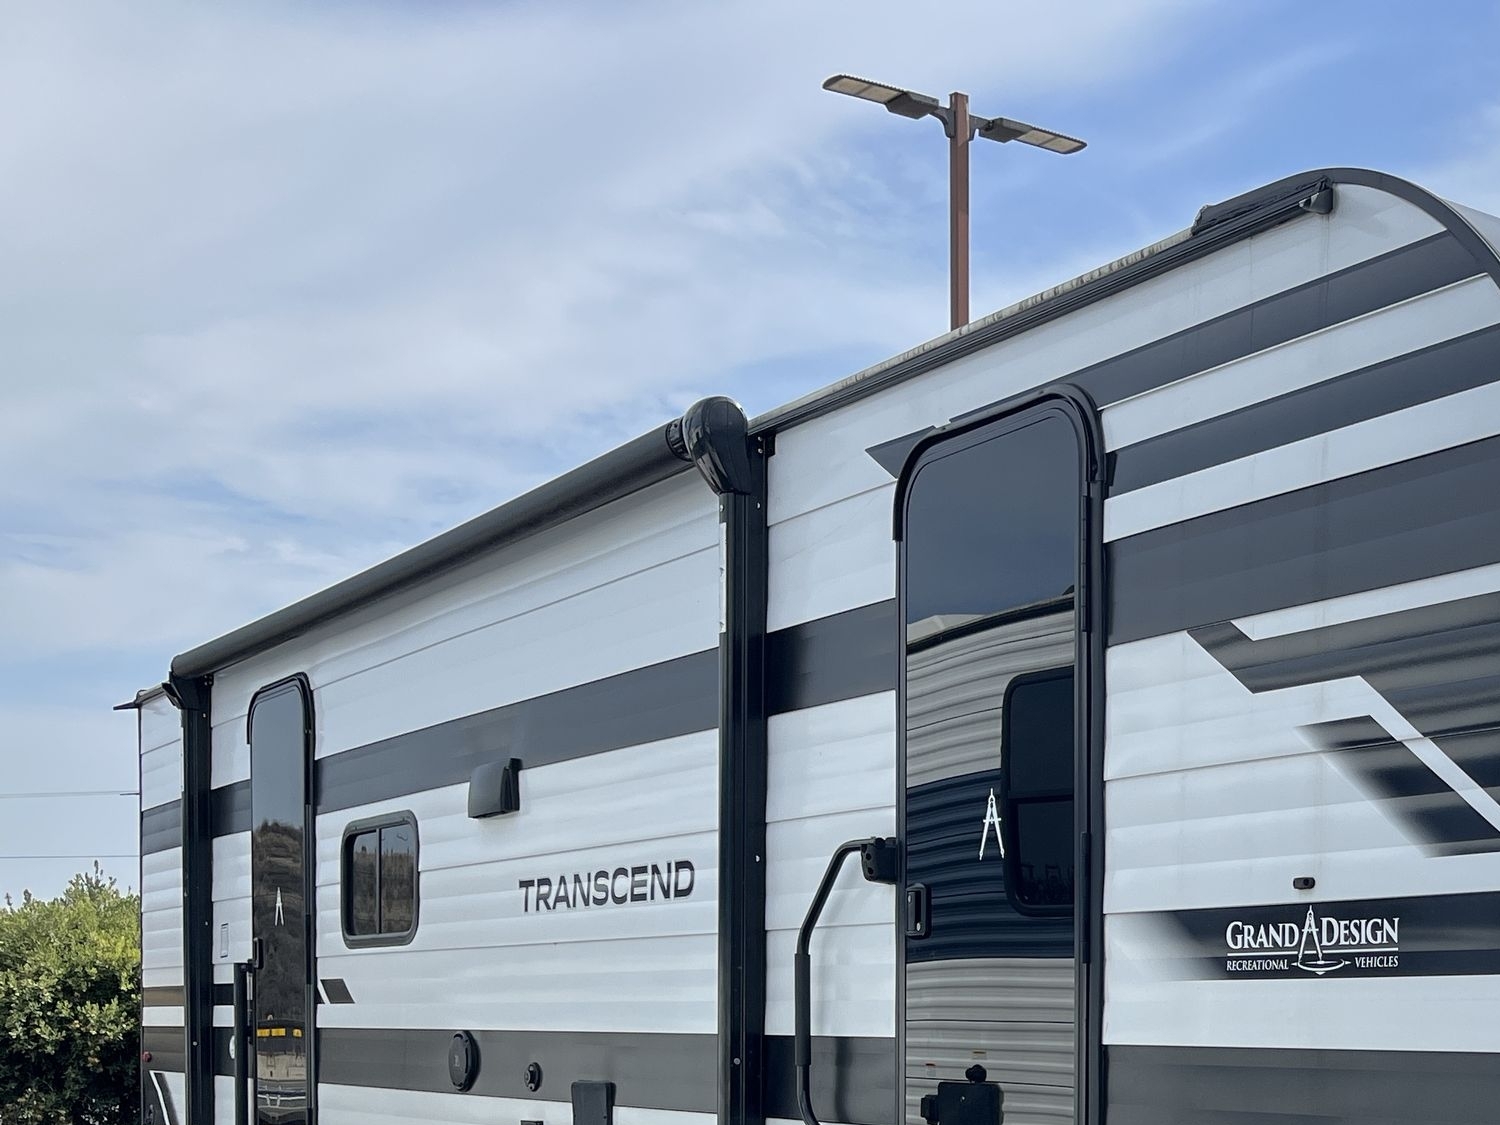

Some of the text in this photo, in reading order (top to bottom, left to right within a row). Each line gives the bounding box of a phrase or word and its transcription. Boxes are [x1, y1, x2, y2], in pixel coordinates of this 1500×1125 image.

[518, 860, 695, 913] TRANSCEND
[1320, 917, 1400, 947] DESIGN
[1226, 956, 1399, 971] RECREATIONAL VEHICLES
